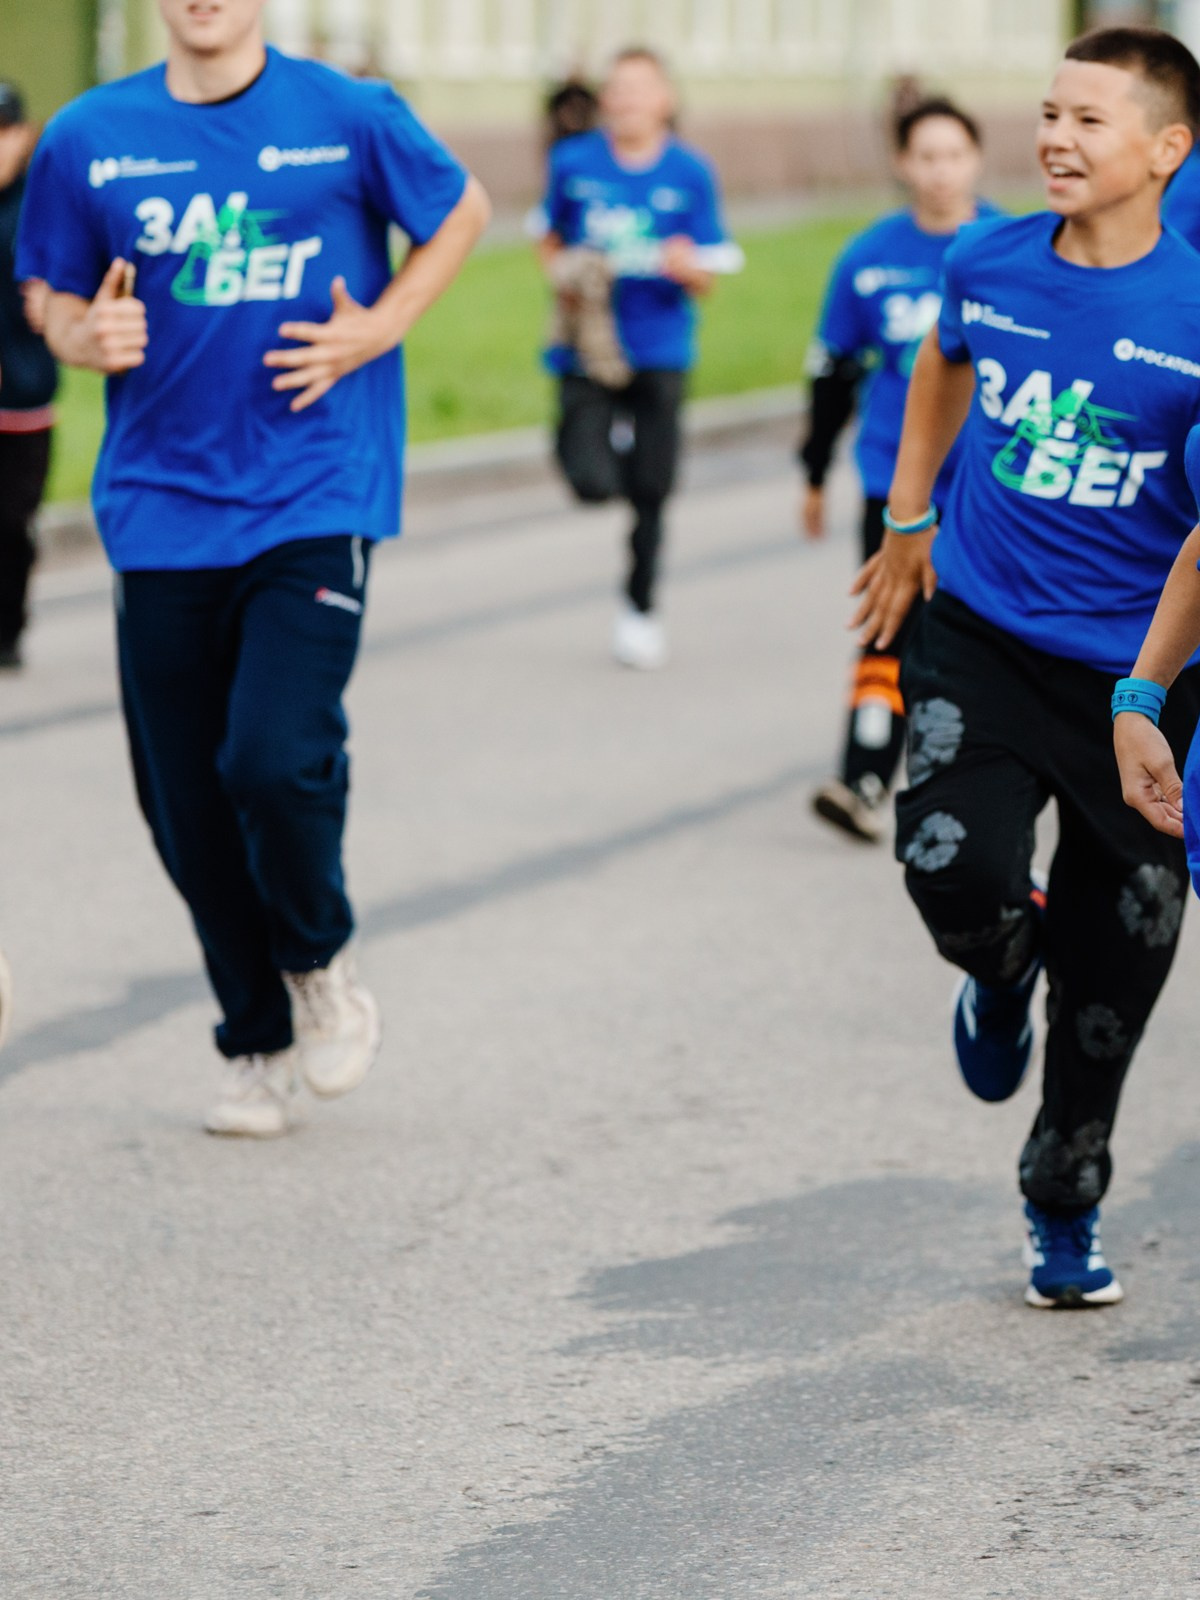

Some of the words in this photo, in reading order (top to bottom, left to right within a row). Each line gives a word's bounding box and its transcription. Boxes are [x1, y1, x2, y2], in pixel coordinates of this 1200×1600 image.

[135, 190, 248, 257] ЗА!
[204, 235, 322, 306] БЕГ
[977, 357, 1095, 440] ЗА!
[1020, 437, 1169, 508] БЕГ
